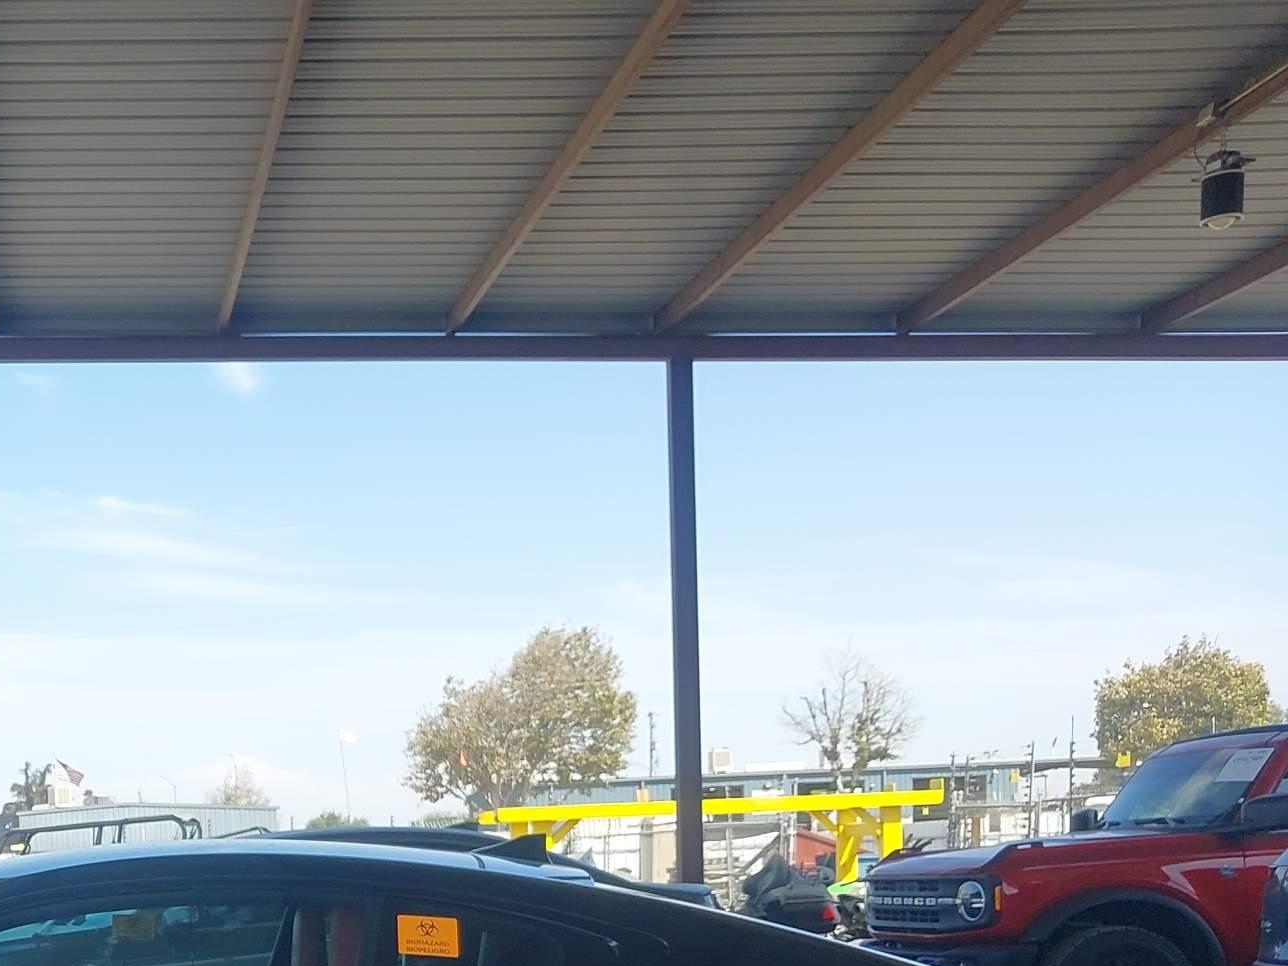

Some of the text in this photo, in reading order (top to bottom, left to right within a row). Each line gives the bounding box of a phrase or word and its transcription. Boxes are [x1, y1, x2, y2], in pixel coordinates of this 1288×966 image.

[871, 896, 937, 906] BRONCO
[406, 938, 450, 947] BIOHAZARD
[406, 946, 450, 955] BIOPELIGRO
